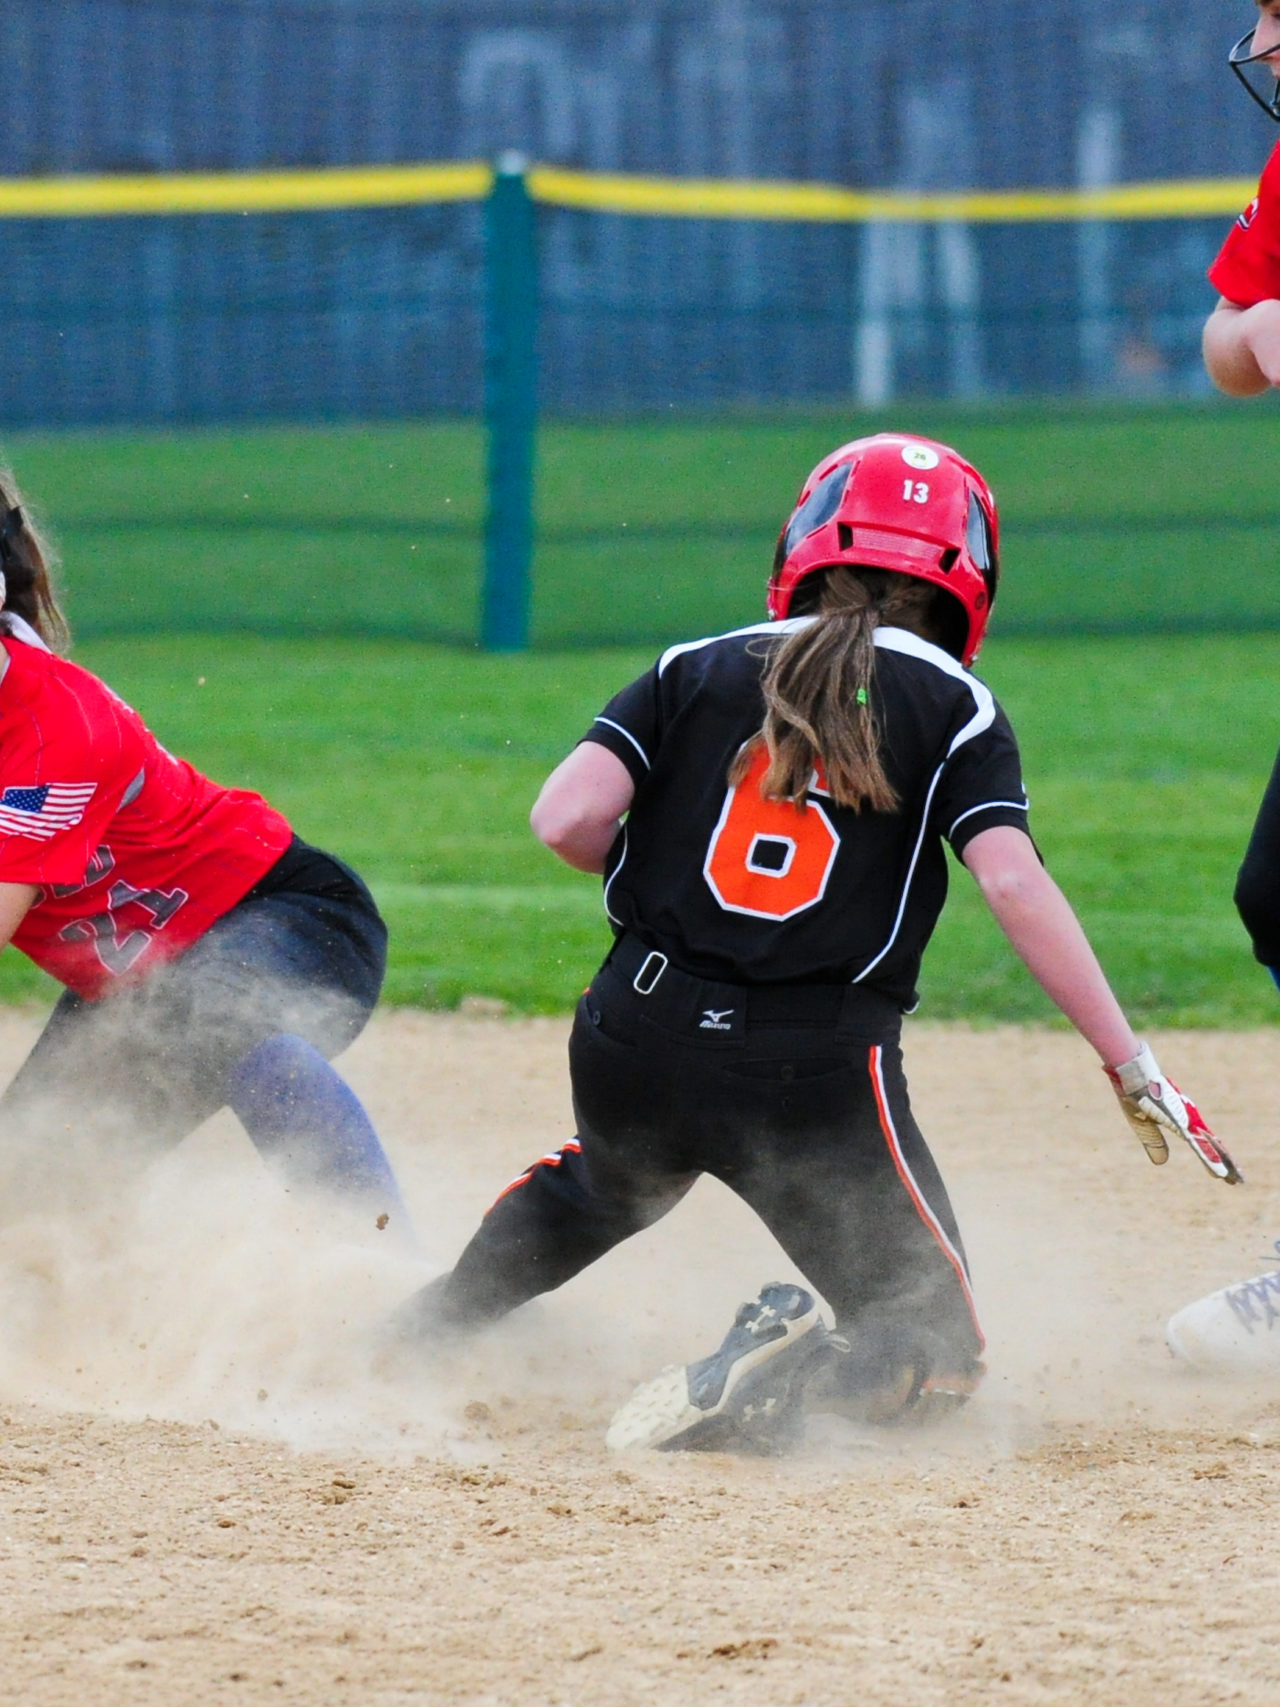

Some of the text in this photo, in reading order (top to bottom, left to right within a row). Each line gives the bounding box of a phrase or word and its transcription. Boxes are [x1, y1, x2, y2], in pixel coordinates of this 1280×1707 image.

[903, 479, 929, 504] 13
[703, 733, 841, 922] 6
[58, 879, 189, 976] 21
